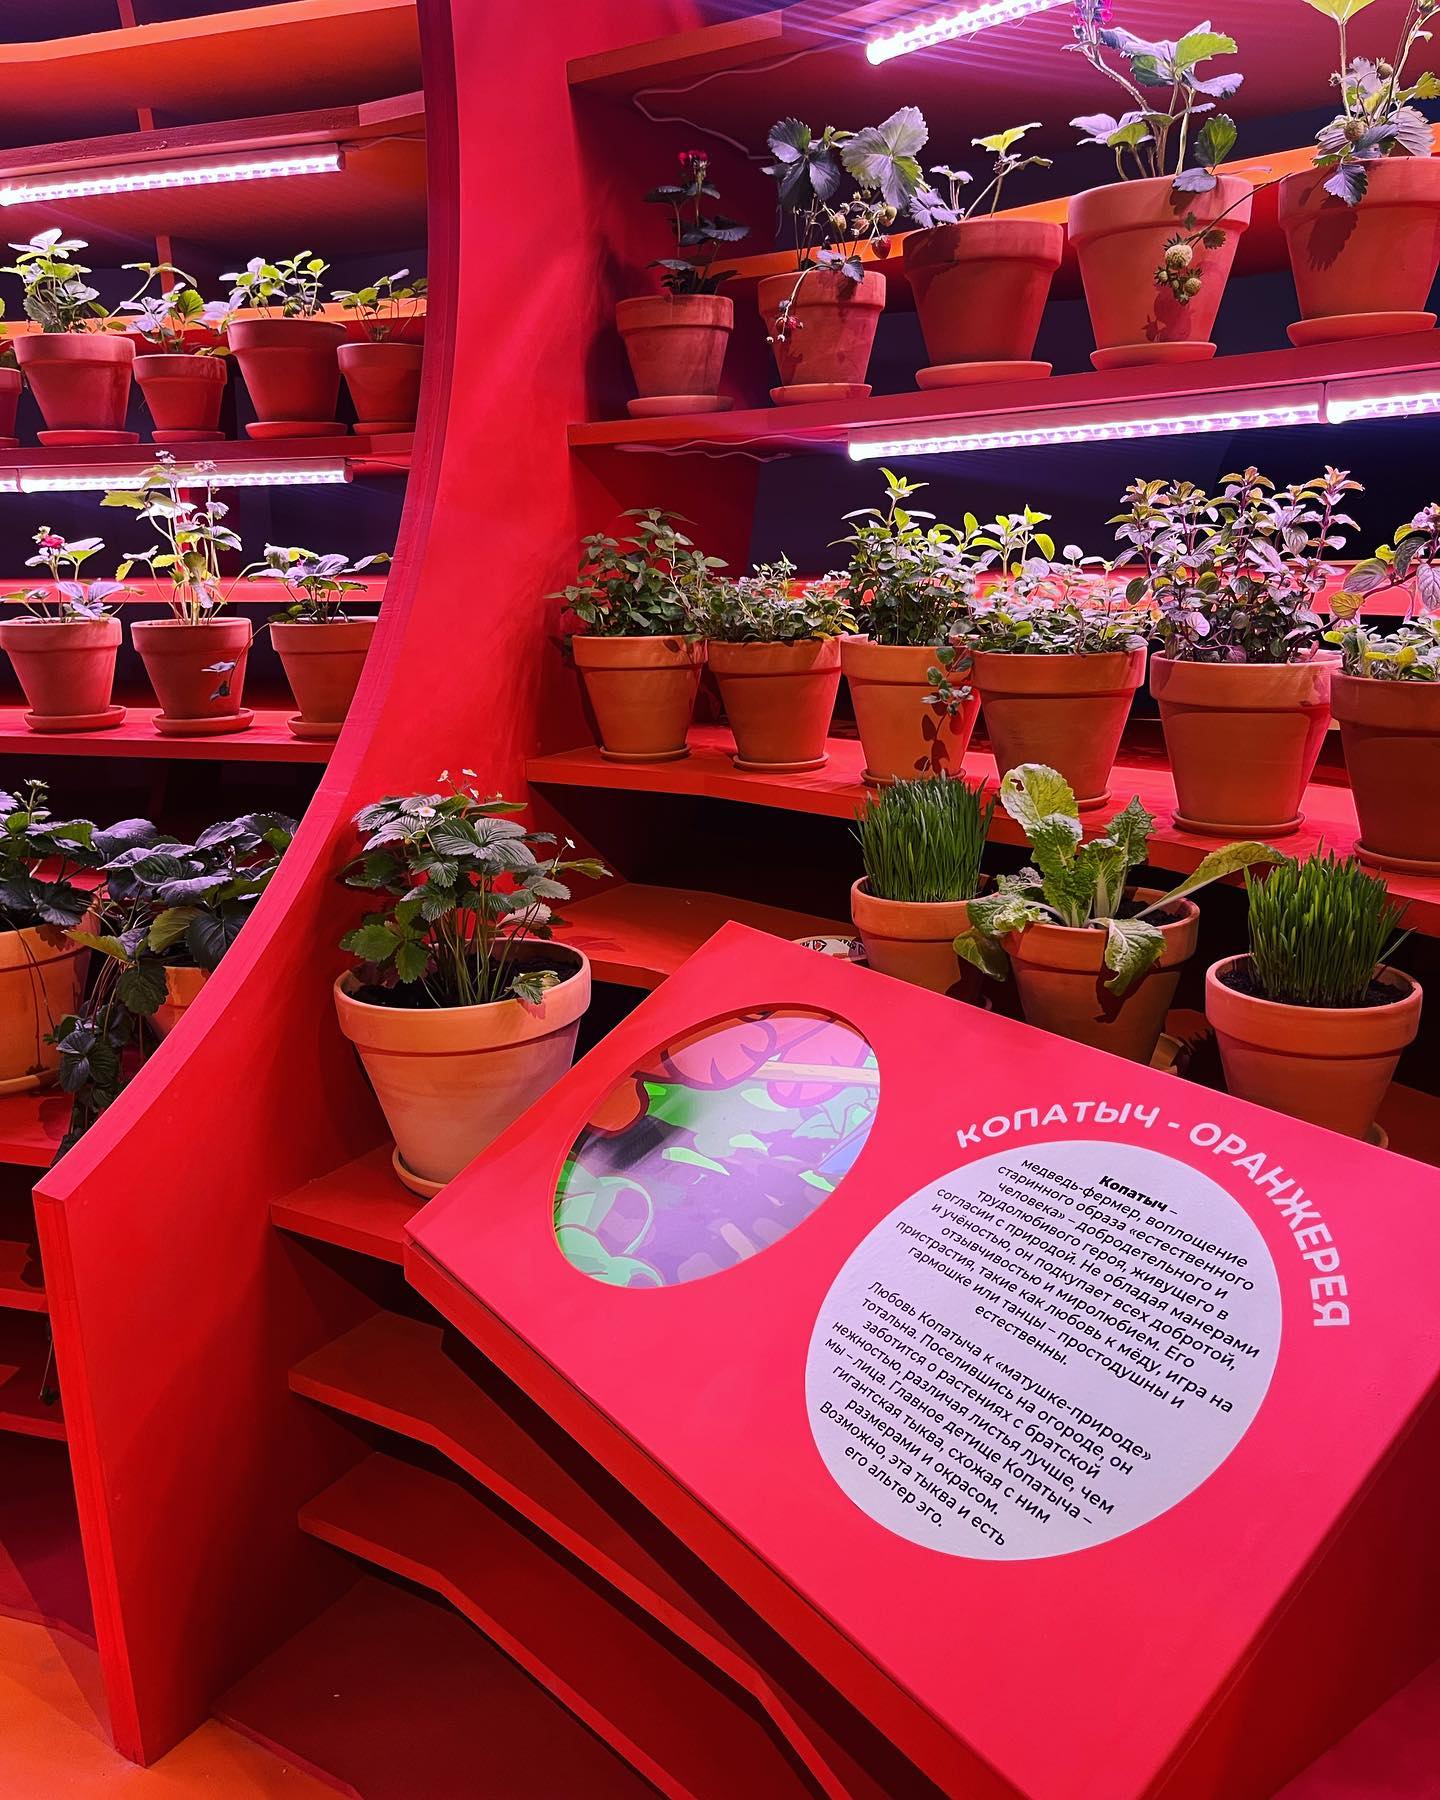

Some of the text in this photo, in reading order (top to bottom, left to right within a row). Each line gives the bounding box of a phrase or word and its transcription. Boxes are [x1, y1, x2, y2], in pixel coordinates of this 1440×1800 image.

[936, 1188, 1260, 1359] согласии с природой. Не обладая манерами
[956, 1101, 1161, 1148] КОПАТЫЧ
[1189, 1122, 1350, 1327] ОРАНЖЕРЕЯ
[977, 1190, 1229, 1321] трудолюбивого героя, живущего в
[997, 1166, 1254, 1291] старинного образа «естественного
[998, 1182, 1066, 1220] человека»
[1074, 1221, 1213, 1291] добродетельного
[1213, 1287, 1229, 1300] и
[1020, 1159, 1248, 1268] медведь-фермер, воплощение
[1098, 1175, 1169, 1213] Копатыч
[895, 1221, 1233, 1414] пристрастия, такие как любовь к мёду, игра на
[907, 1246, 973, 1287] гармошке
[972, 1283, 1001, 1304] или
[1001, 1298, 1047, 1330] танцы
[1056, 1331, 1170, 1400] простодушны
[1170, 1395, 1185, 1409] и
[931, 1203, 1236, 1372] и учёностью, он подкупает всех добротой,
[941, 1227, 1195, 1368] отзывчивостью и миролюбием. Его
[974, 1305, 1067, 1366] естественны.
[824, 1338, 847, 1356] мы
[851, 1358, 886, 1386] лица.
[888, 1379, 945, 1424] Главное
[941, 1420, 1002, 1464] детище
[1001, 1457, 1081, 1519] Копатыча
[831, 1321, 1115, 1515] нежностью, различая листья лучше, чем
[832, 1365, 1051, 1524] гигантская тыква, схожая с ним
[861, 1297, 1134, 1476] тотальна. Поселившись на огороде, он
[862, 1320, 1102, 1480] заботится о растениях с братской
[867, 1281, 1151, 1461] Любовь Копатыча к «матушке-природе»
[819, 1400, 1005, 1546] Возможно, эта тыква и есть
[844, 1399, 999, 1516] размерами и окрасом.
[844, 1446, 942, 1528] его альтер эго.
